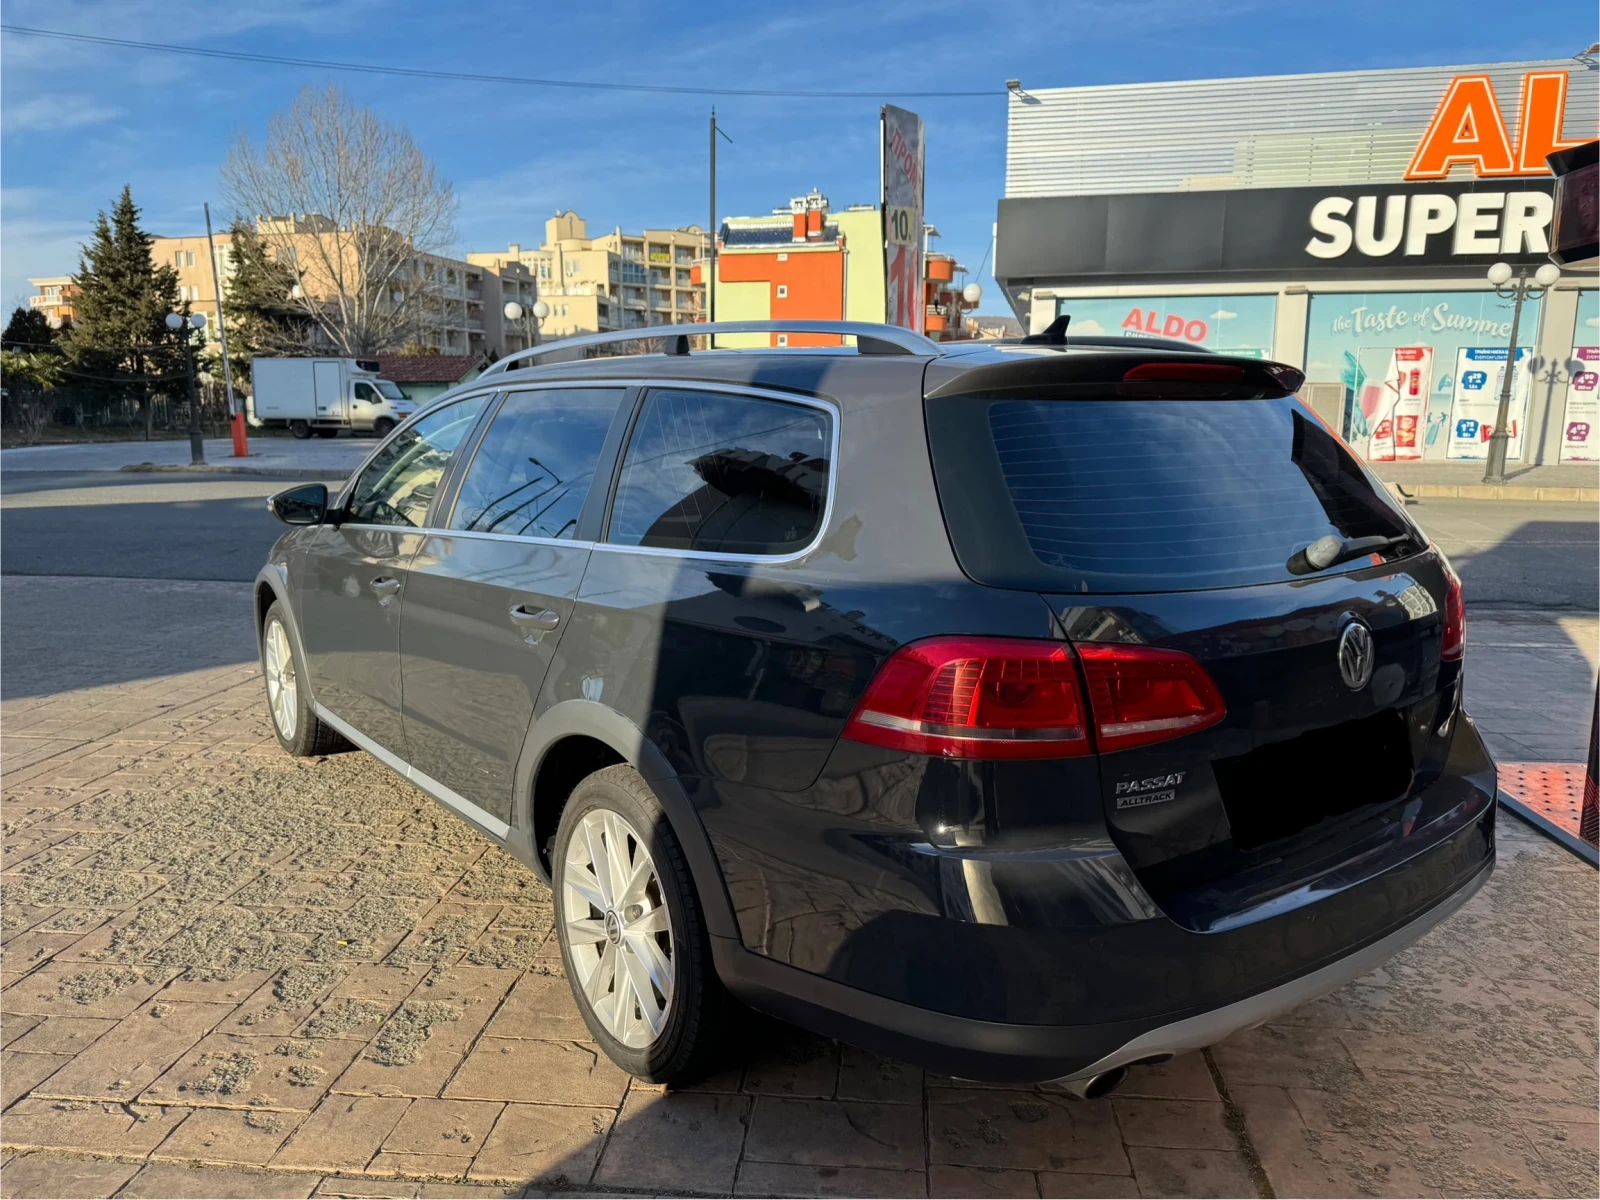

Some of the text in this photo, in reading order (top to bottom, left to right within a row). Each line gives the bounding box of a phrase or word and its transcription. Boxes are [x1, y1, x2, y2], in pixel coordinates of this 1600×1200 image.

[1304, 191, 1553, 258] SUPER
[1121, 307, 1208, 343] ALDO
[1351, 305, 1410, 333] Taste
[1413, 307, 1430, 328] of
[1431, 302, 1514, 338] Summe
[1116, 771, 1186, 794] PASSAT
[1121, 791, 1173, 807] ALLTRACK
